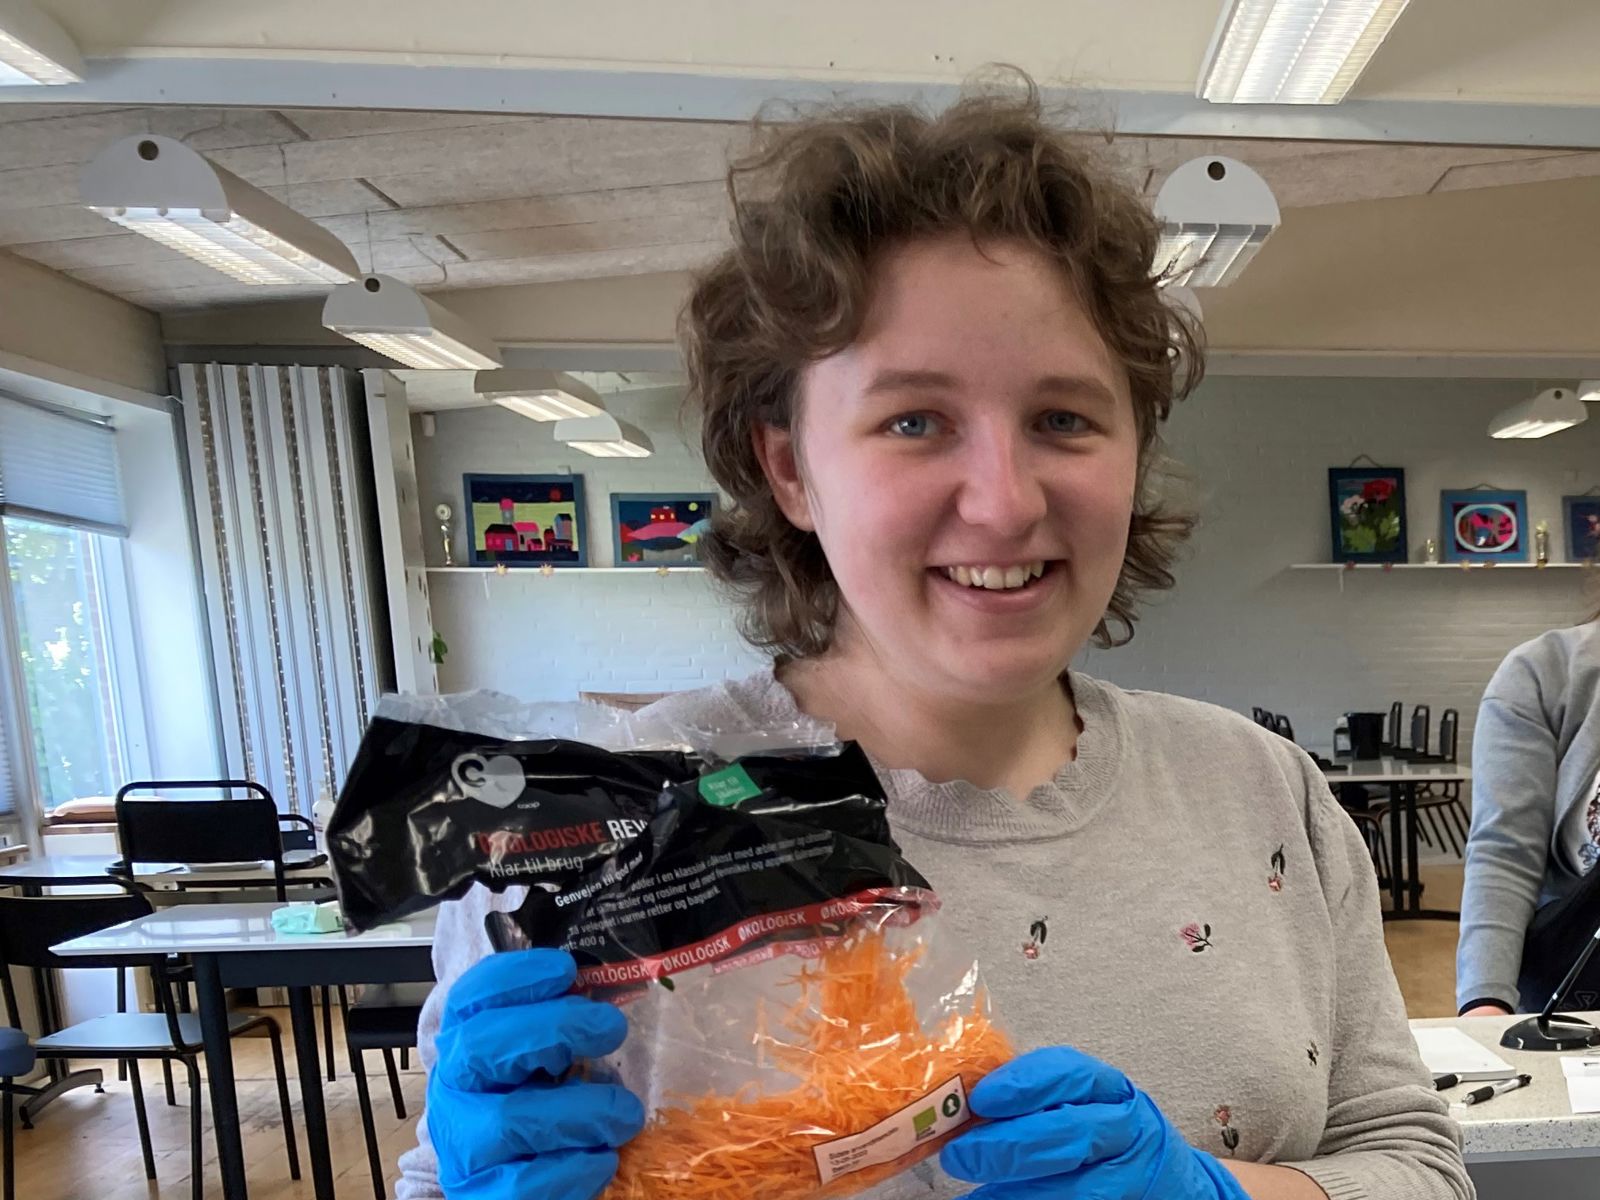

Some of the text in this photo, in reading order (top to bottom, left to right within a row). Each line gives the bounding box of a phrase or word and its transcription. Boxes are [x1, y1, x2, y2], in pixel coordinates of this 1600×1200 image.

[477, 818, 649, 855] ØOLOGISKE REV
[525, 856, 542, 874] til
[545, 855, 584, 873] brug
[555, 882, 602, 907] Genvejen
[579, 937, 597, 947] 400
[598, 935, 606, 945] g
[661, 936, 731, 972] ØKOLOGISK
[738, 911, 806, 941] ØKOLOGISK
